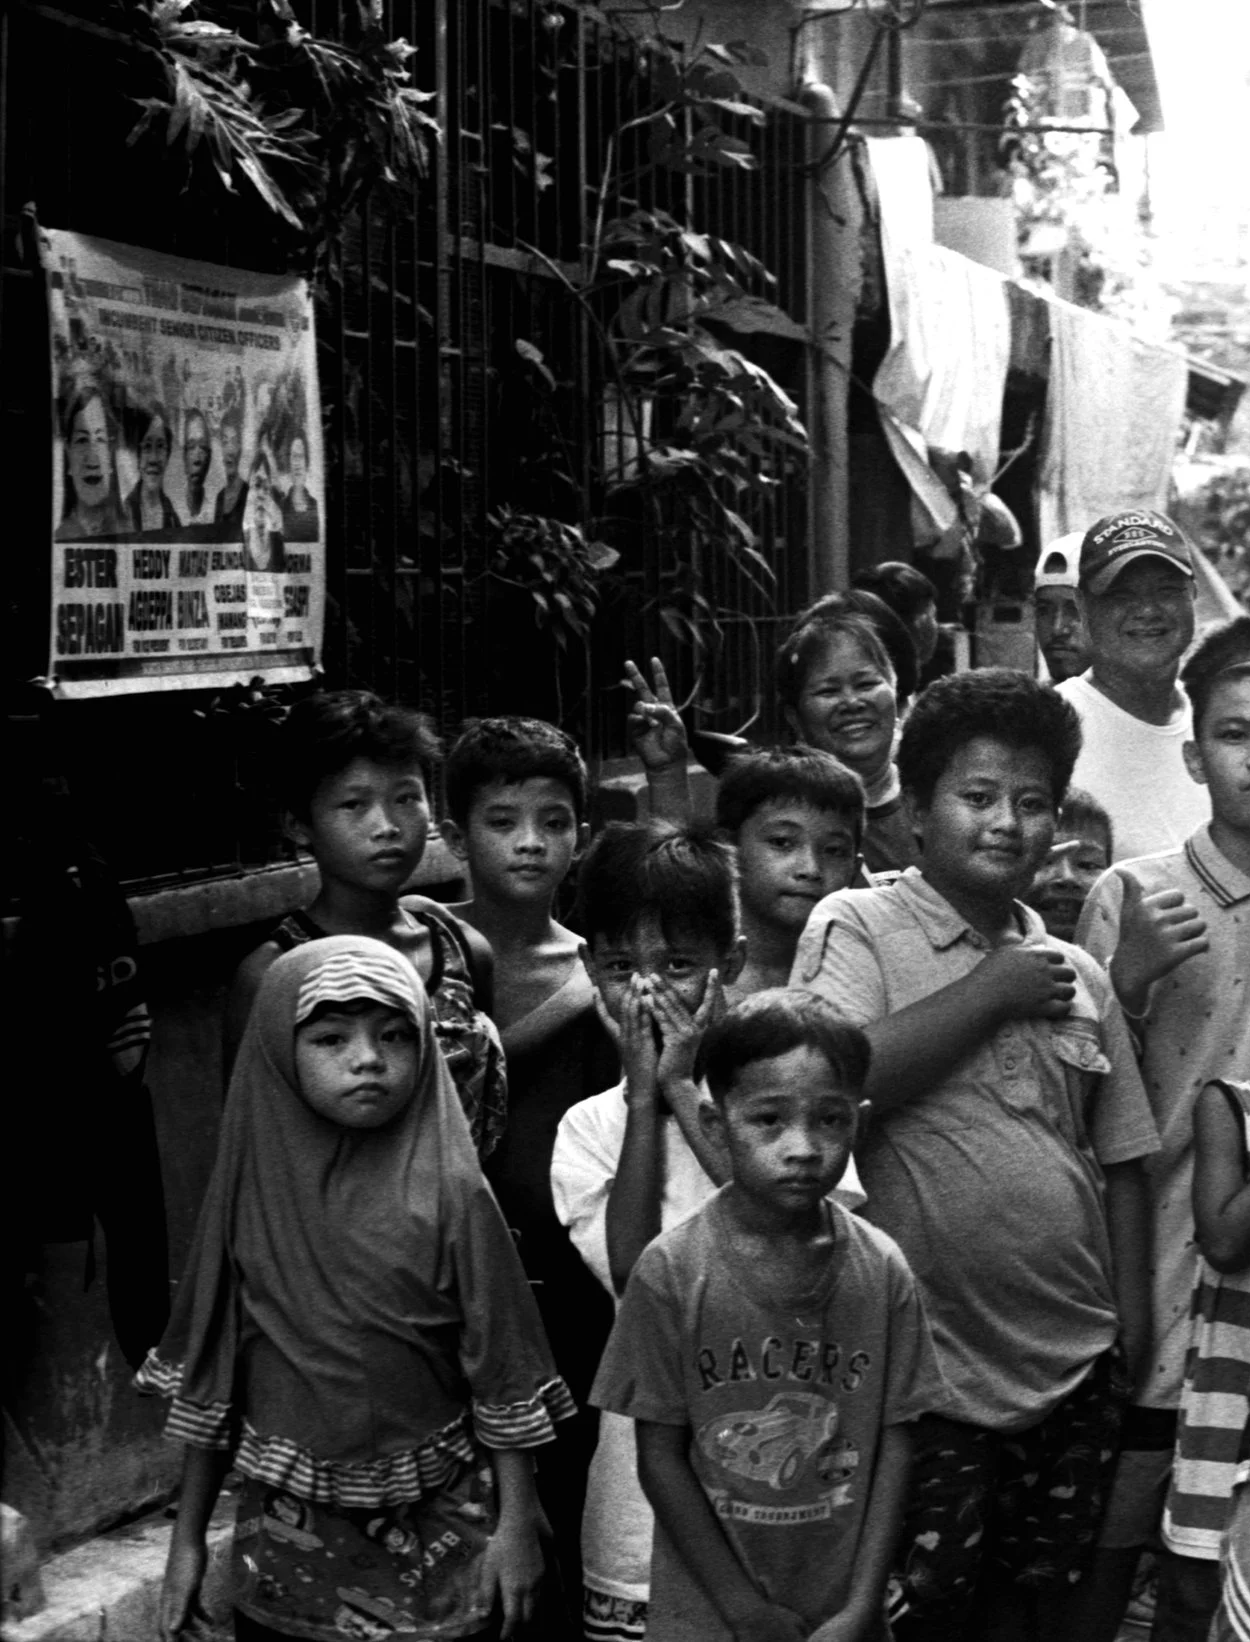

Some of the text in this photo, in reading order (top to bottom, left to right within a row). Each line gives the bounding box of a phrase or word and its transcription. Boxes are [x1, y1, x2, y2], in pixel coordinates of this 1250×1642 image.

[160, 318, 196, 340] SENIOR
[198, 324, 236, 345] CITIZEN
[237, 331, 281, 352] OFFICERS
[1093, 516, 1173, 544] STANDARD
[64, 548, 117, 588] ESTER
[132, 550, 171, 579] HEDDY
[283, 554, 311, 573] ORMA
[56, 603, 124, 655] SEPAGAN
[699, 1337, 871, 1392] RACERS
